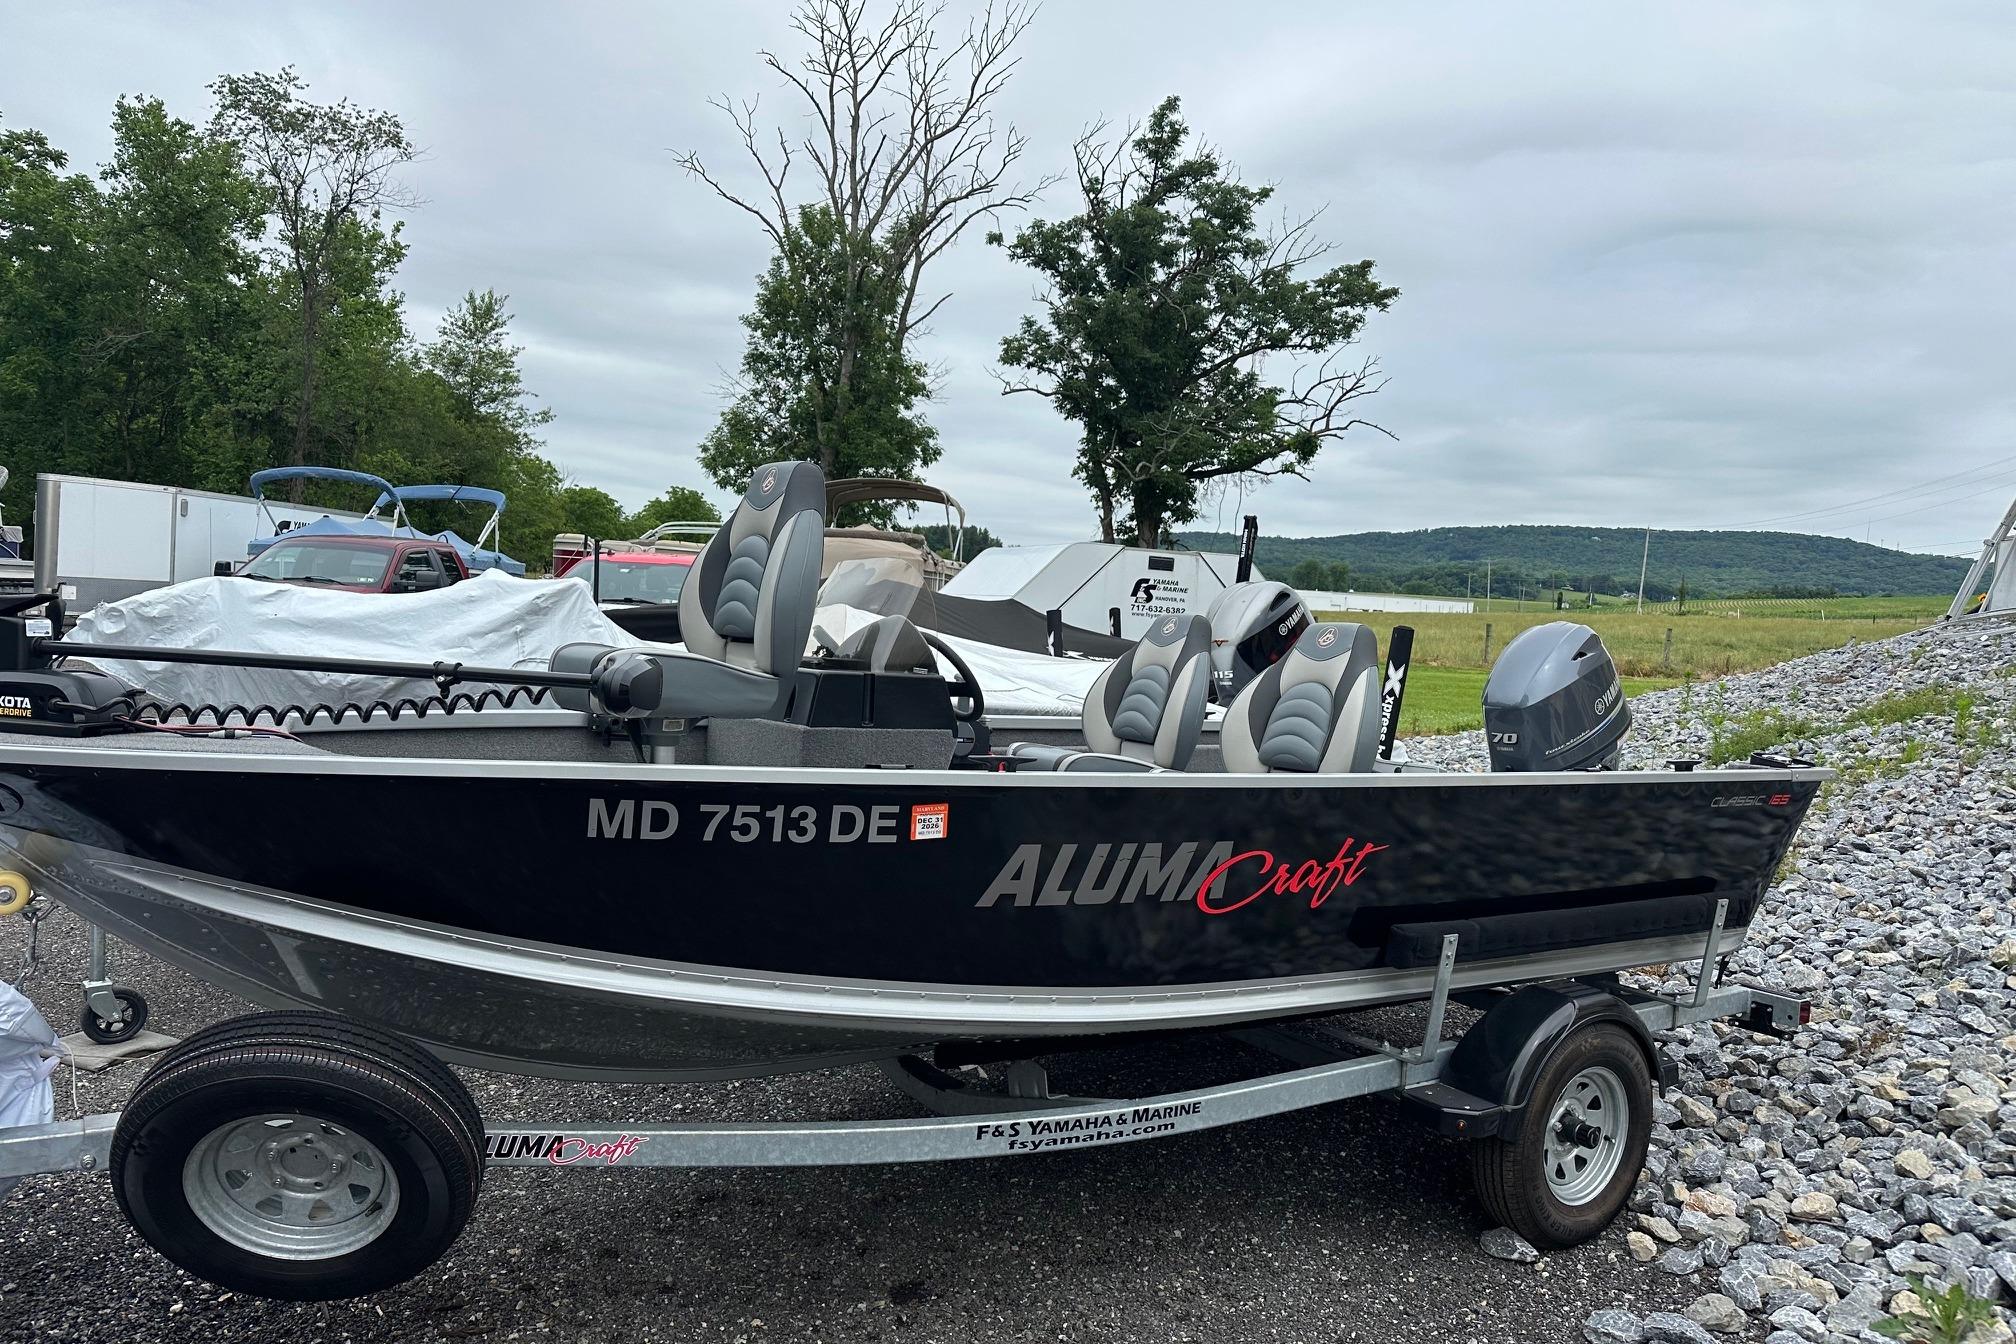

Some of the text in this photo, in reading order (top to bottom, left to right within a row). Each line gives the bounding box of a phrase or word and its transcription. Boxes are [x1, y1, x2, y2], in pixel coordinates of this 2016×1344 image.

[1162, 586, 1189, 594] MARINE
[1131, 604, 1186, 614] 717-632-6382
[1213, 670, 1234, 679] 115
[1491, 732, 1518, 744] 70
[1711, 794, 1792, 808] CLASSIC 165
[586, 798, 901, 843] MD 7513 DE
[1027, 1115, 1113, 1136] YAMAHA
[1115, 1113, 1128, 1126] &
[1131, 1101, 1202, 1124] MARINE
[1008, 1121, 1175, 1151] fsyamaha.com
